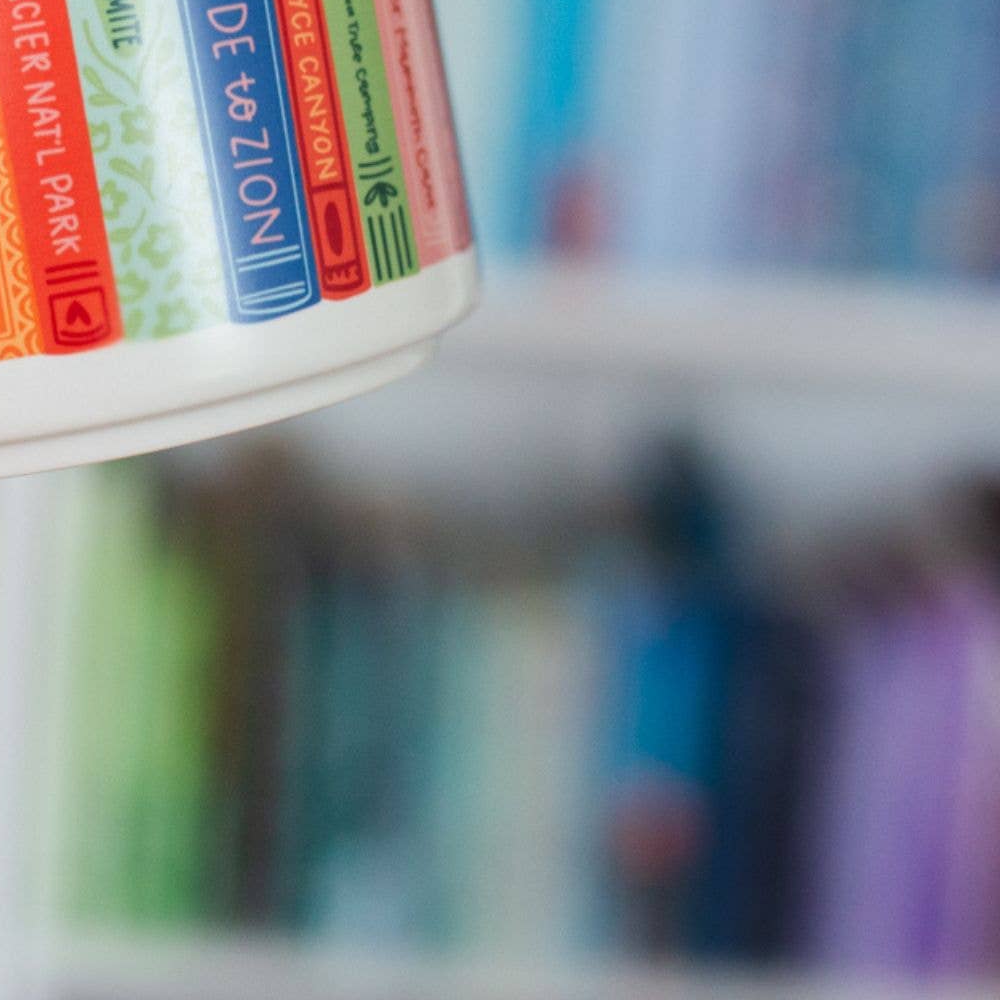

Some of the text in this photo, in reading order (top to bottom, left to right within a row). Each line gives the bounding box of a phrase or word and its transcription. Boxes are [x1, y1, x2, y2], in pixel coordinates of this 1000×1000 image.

[23, 81, 67, 167] NAT'L
[224, 72, 258, 123] to
[298, 55, 338, 181] CANYON
[40, 173, 82, 257] PARK
[231, 127, 286, 245] ZION
